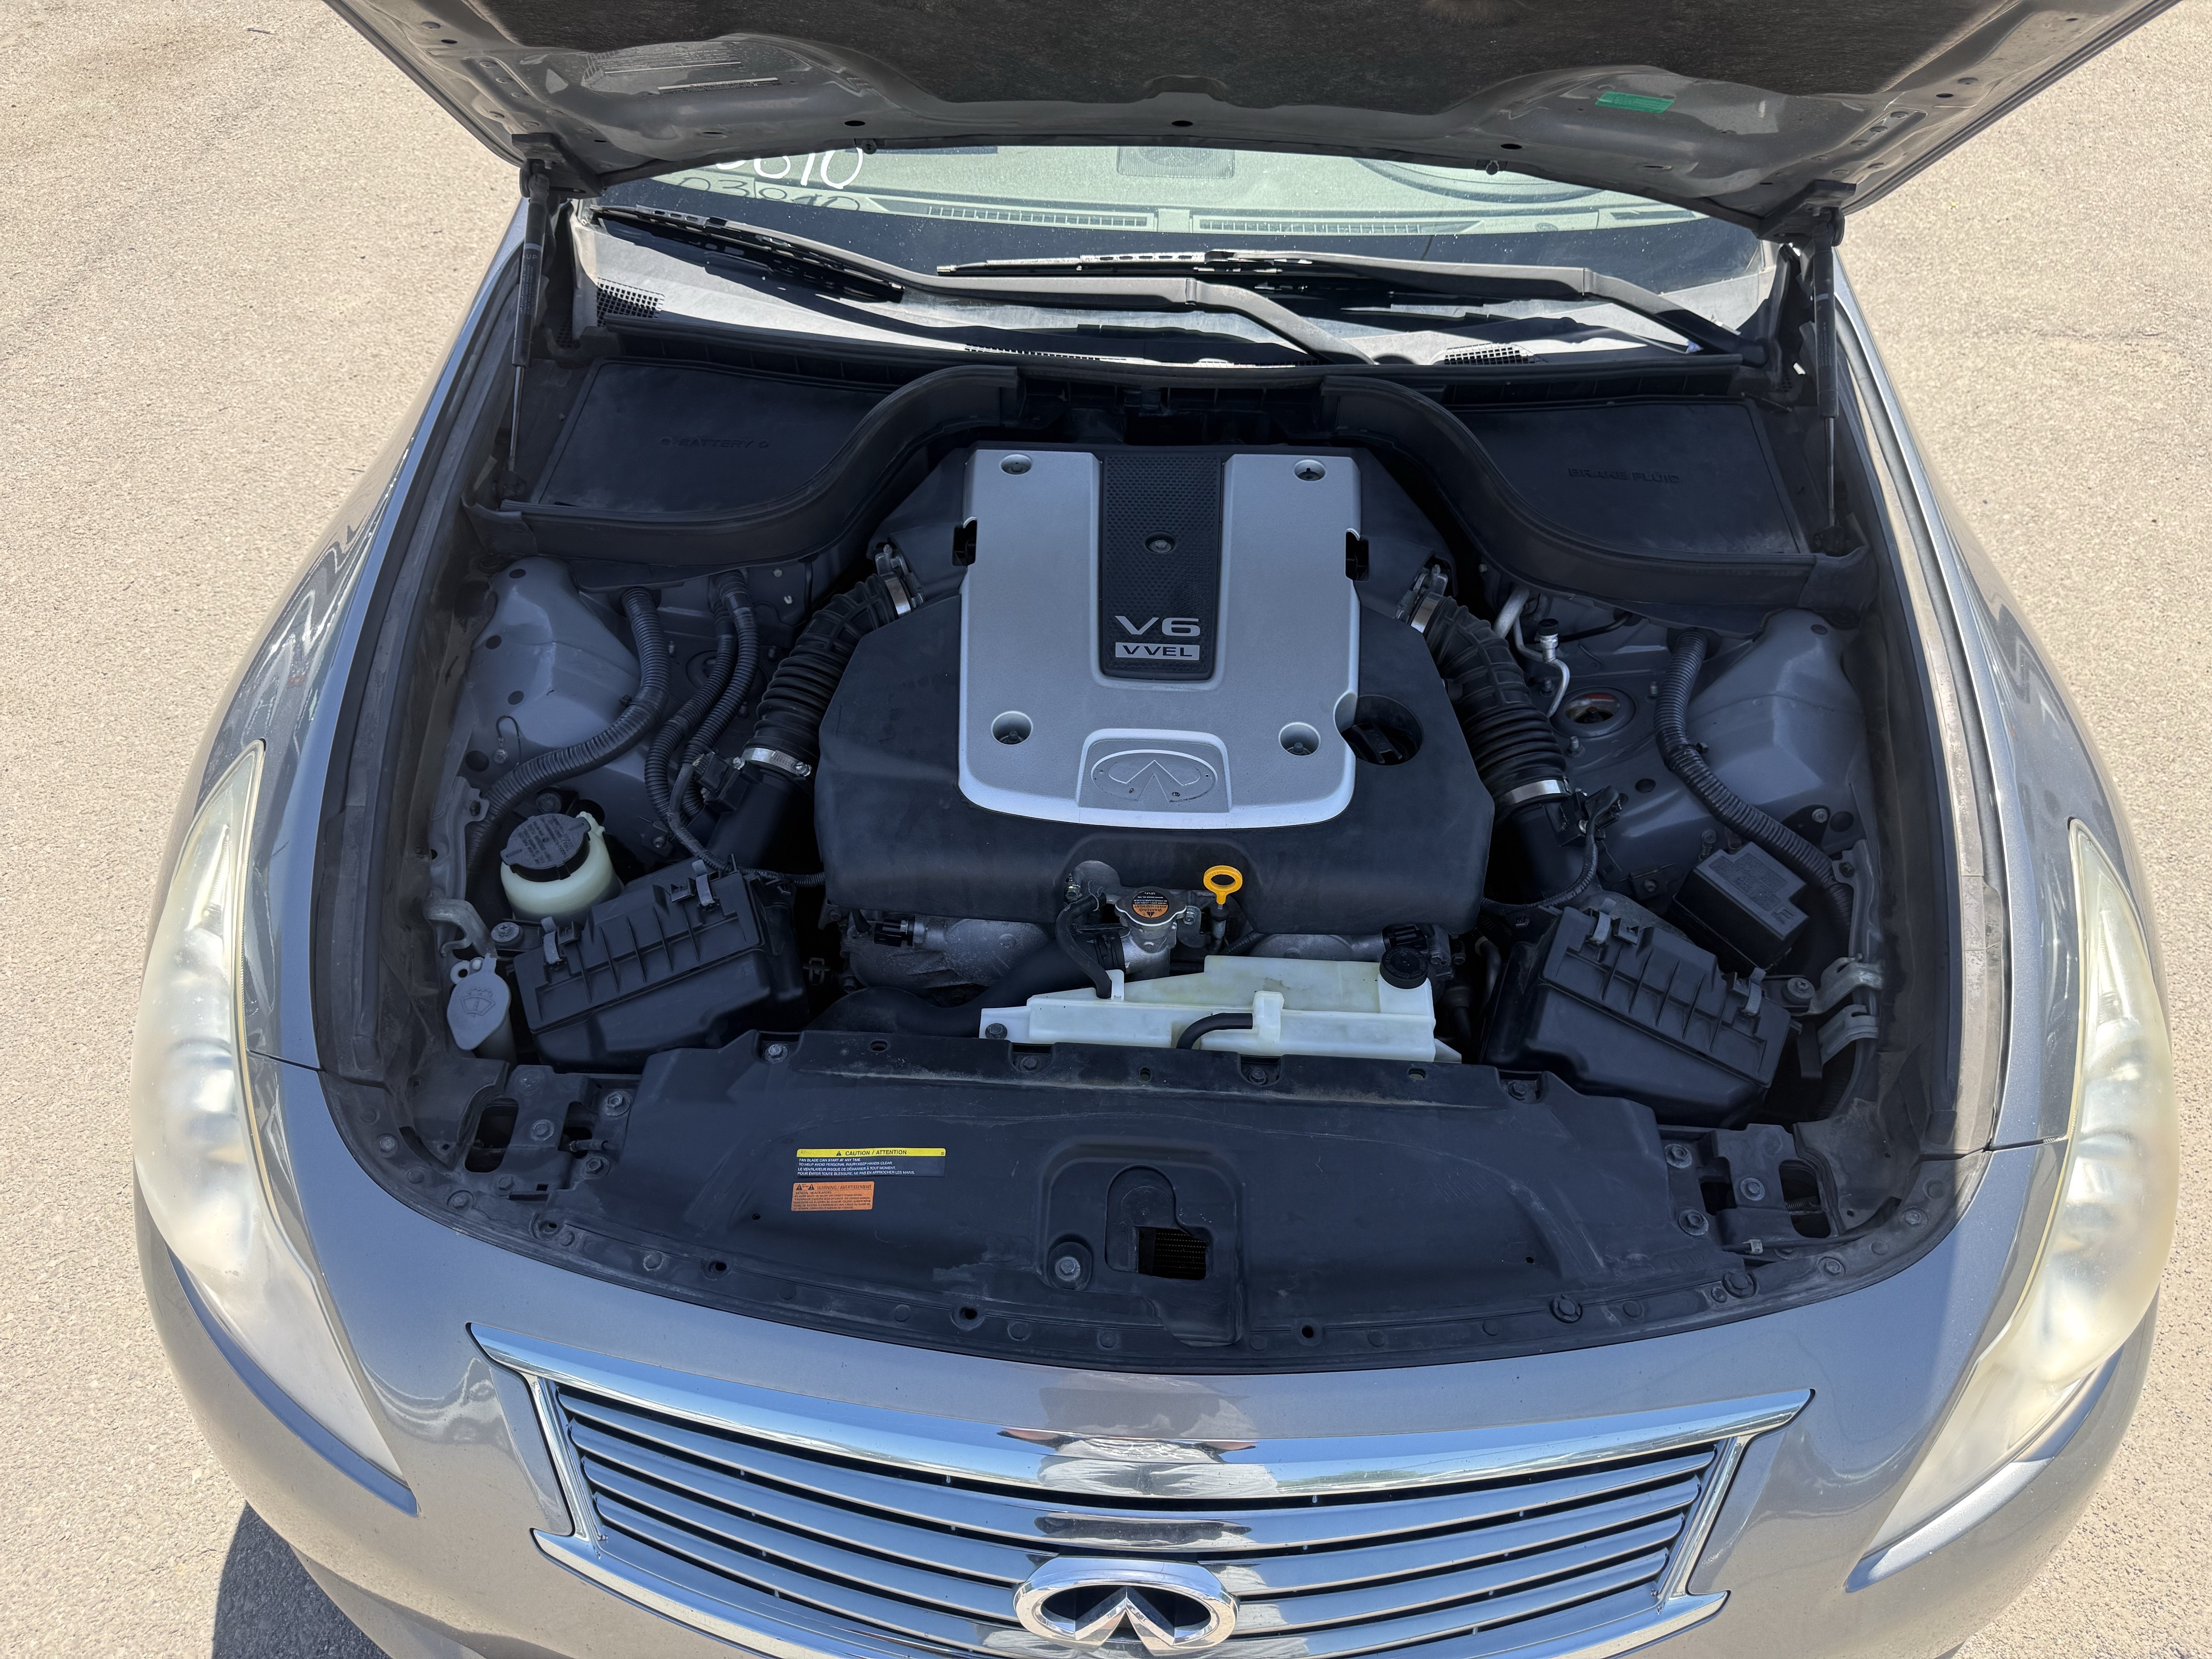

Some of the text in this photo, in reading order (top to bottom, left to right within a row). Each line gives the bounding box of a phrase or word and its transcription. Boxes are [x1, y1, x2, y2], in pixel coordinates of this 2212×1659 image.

[678, 438, 754, 448] BATTERY
[1568, 468, 1680, 483] BRAKE FLUID
[1115, 615, 1200, 637] V6
[1122, 645, 1192, 657] VVEL
